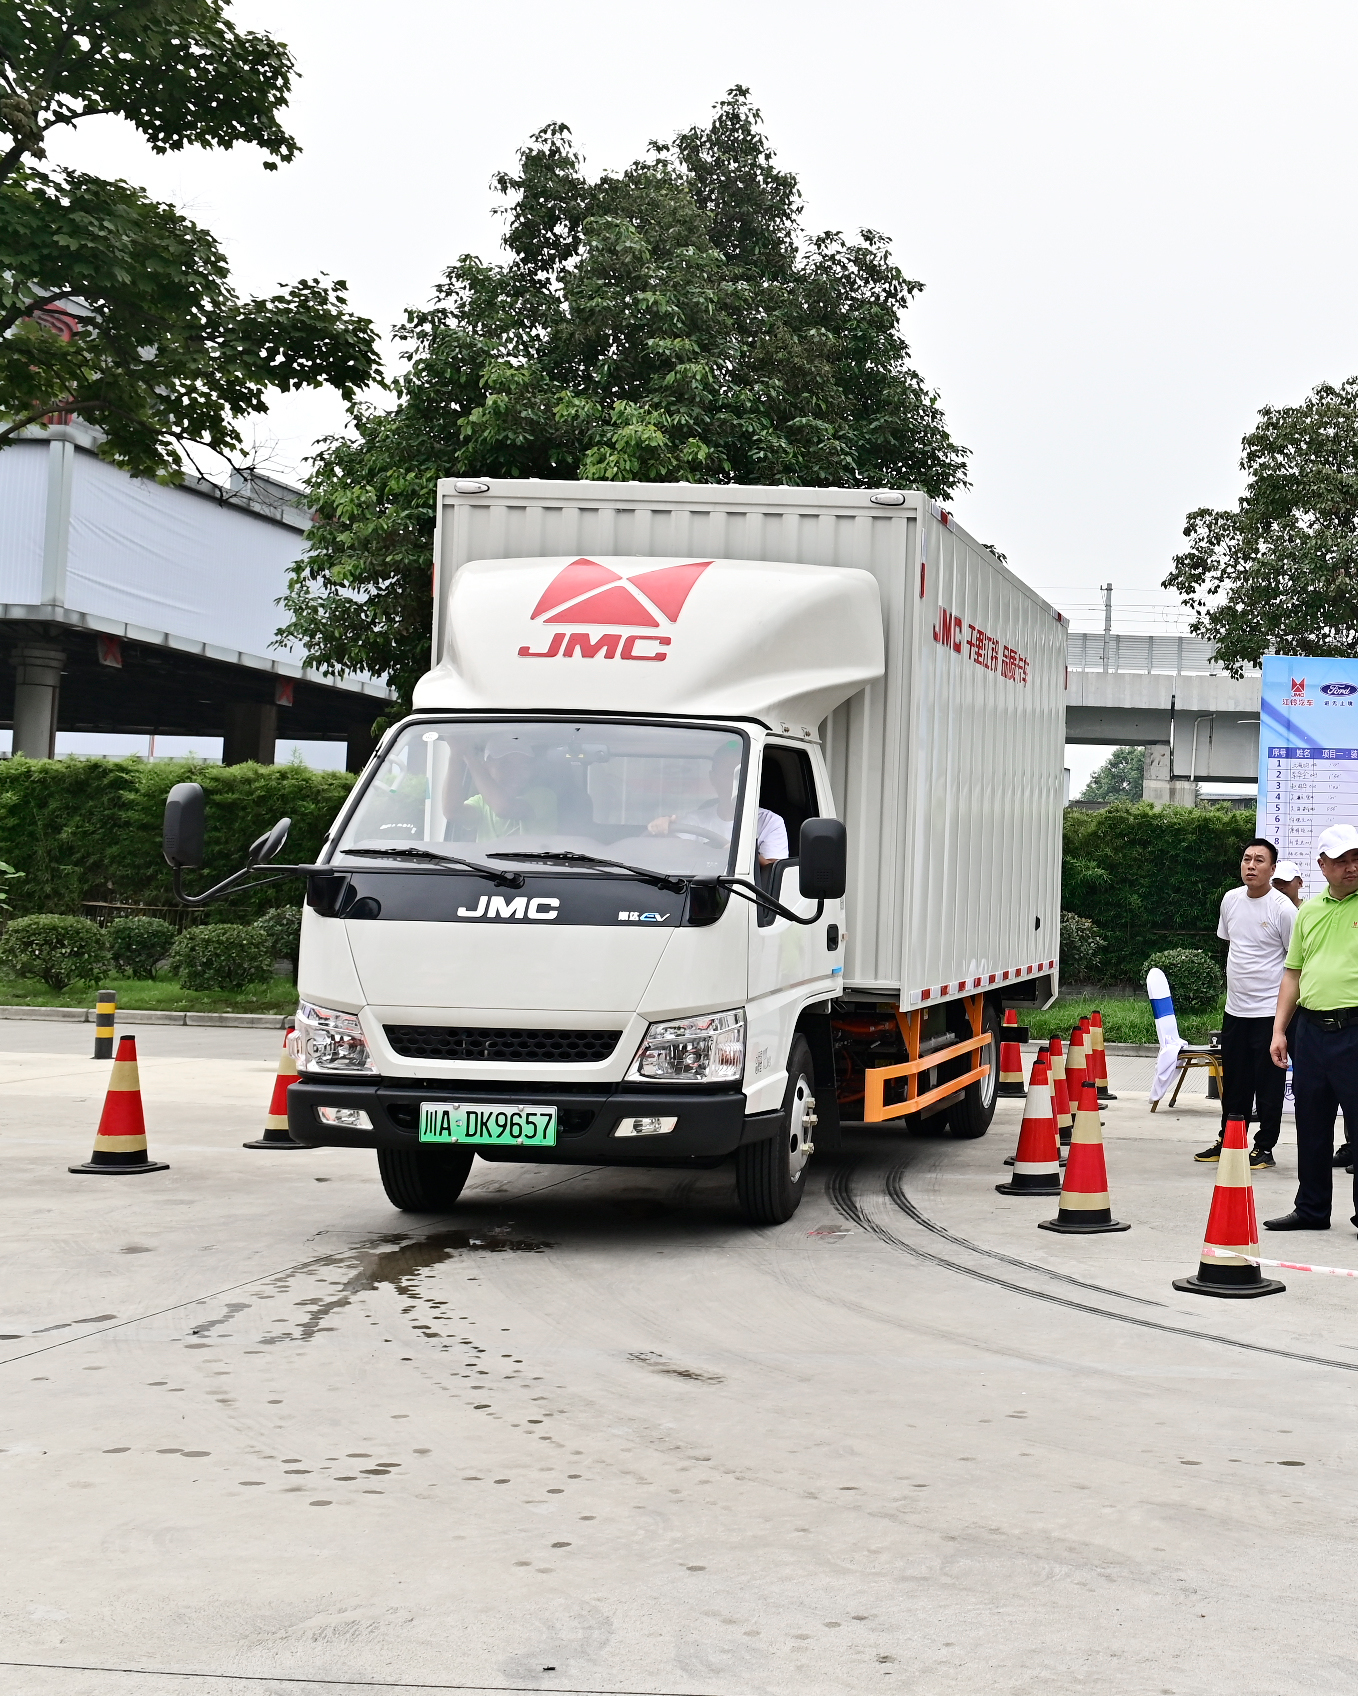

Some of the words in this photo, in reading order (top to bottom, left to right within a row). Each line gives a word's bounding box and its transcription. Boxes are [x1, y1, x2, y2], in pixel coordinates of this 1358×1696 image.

[933, 605, 962, 655] JMC
[517, 632, 672, 662] JMC
[1282, 698, 1314, 706] 江铃汽车
[1272, 748, 1287, 758] 序号
[1296, 749, 1311, 758] 姓名
[1274, 837, 1280, 845] 8
[457, 895, 560, 919] JMC
